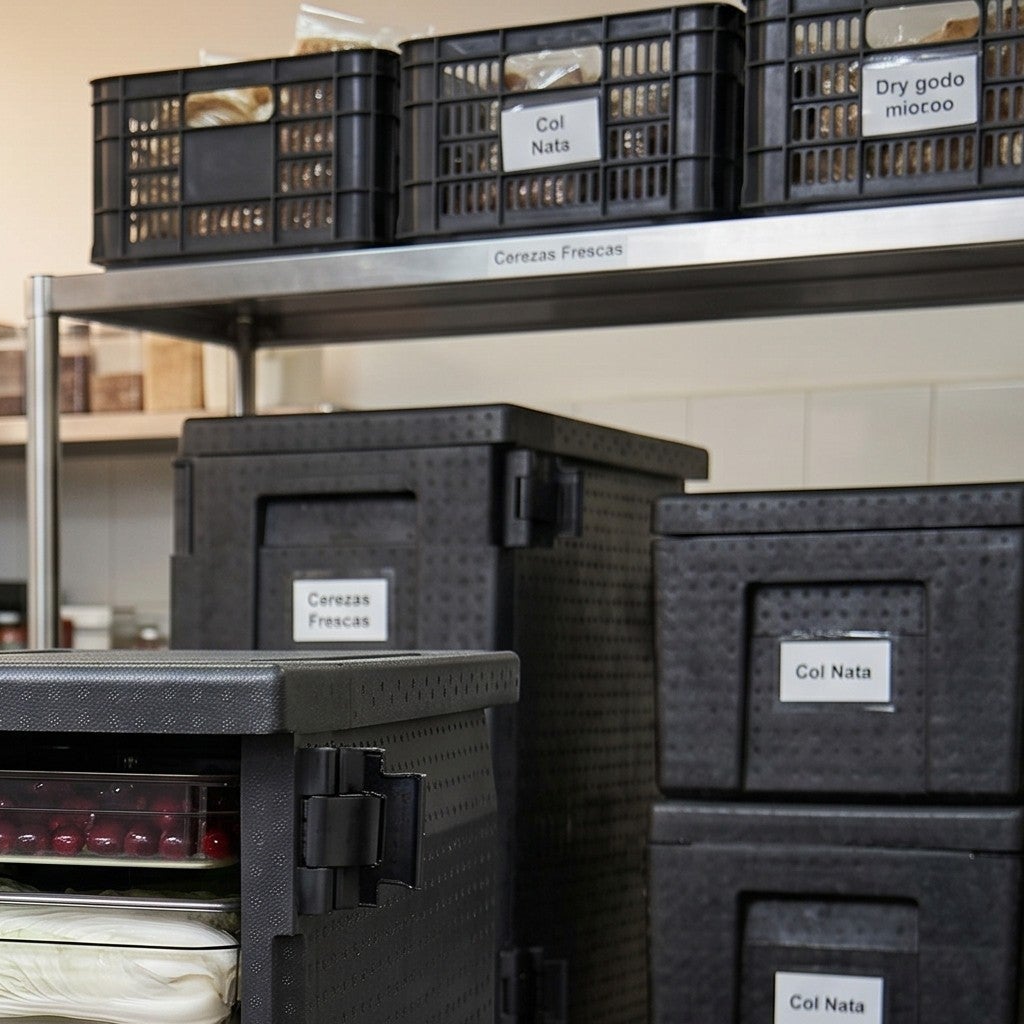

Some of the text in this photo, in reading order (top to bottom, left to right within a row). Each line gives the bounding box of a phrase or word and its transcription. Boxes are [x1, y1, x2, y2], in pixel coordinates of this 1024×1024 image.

[876, 72, 965, 97] Dry godo
[536, 115, 565, 132] Col
[494, 244, 624, 265] Cerezas Frescas
[307, 592, 371, 608] Cerezas
[308, 613, 371, 629] Frescas
[796, 664, 872, 679] Col Nata
[789, 995, 865, 1013] Col Nata
